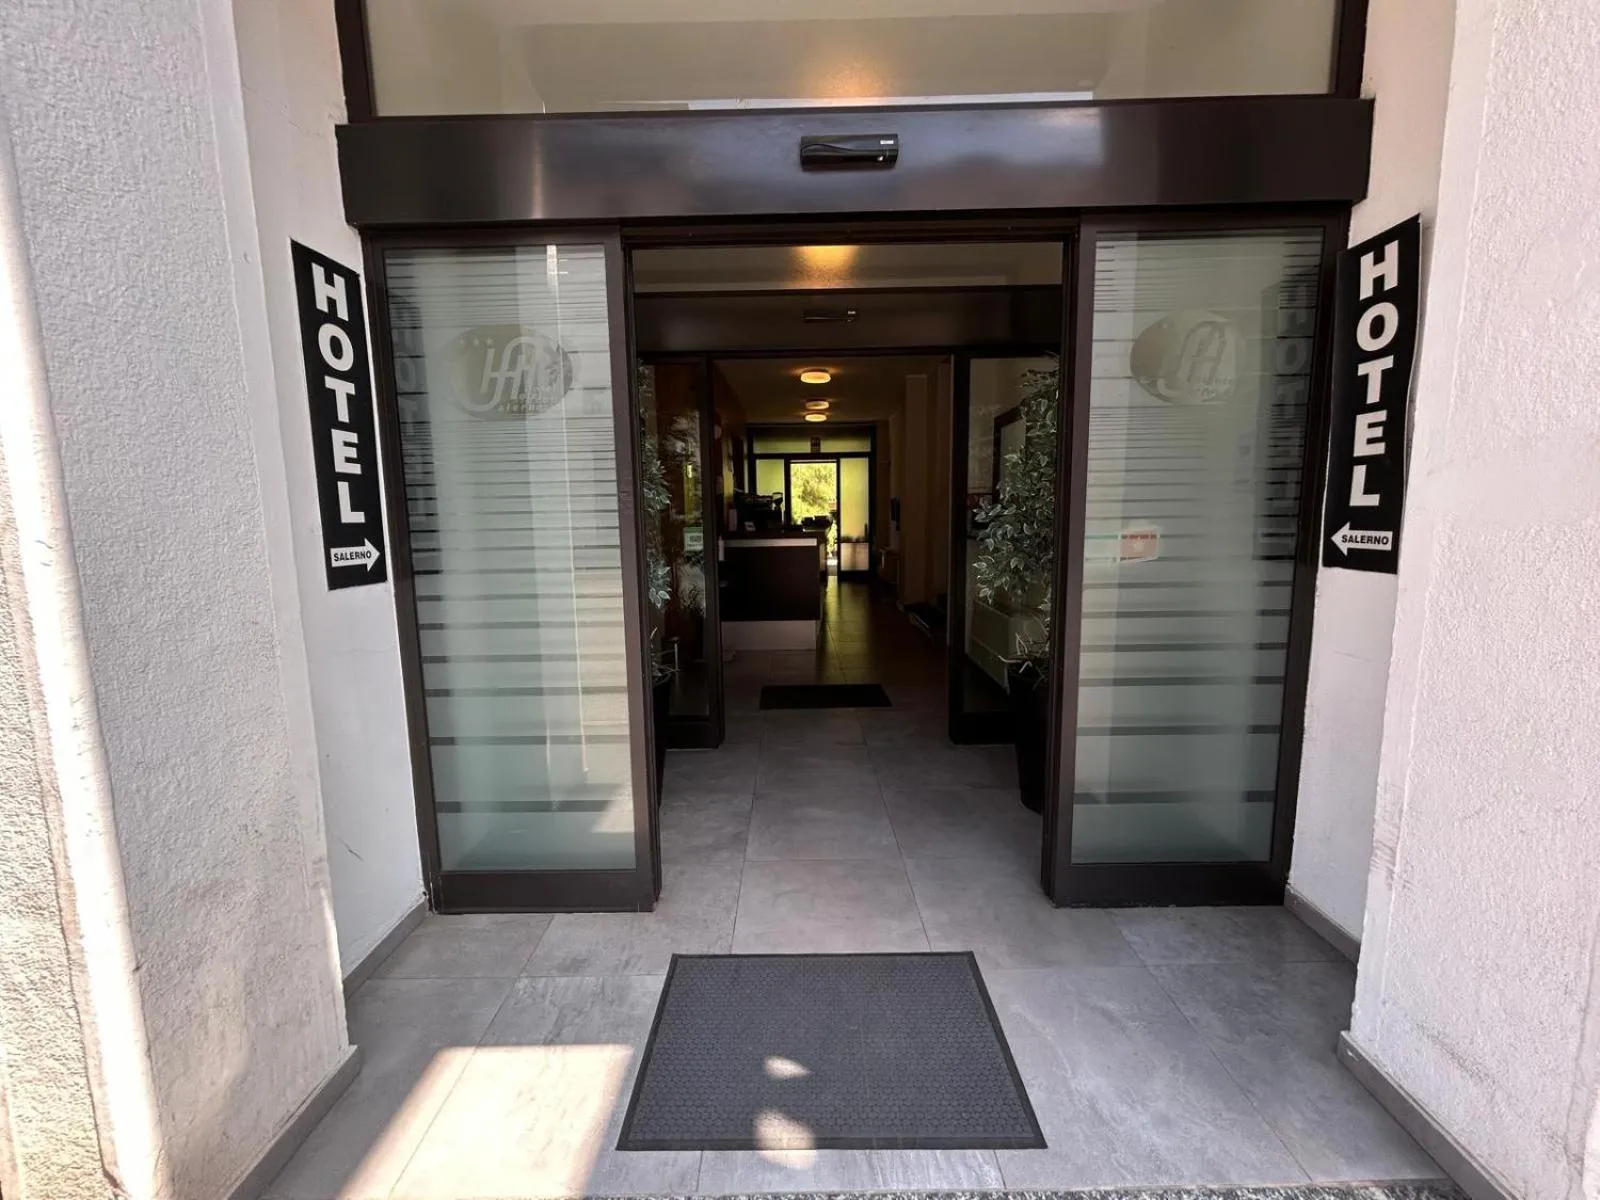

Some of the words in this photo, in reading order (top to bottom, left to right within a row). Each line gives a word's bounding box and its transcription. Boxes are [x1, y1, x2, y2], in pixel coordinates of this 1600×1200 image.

[311, 262, 366, 524] HOTEL
[1349, 240, 1399, 506] HOTEL
[333, 549, 372, 562] SALERNO
[1341, 533, 1390, 546] SALERNO
